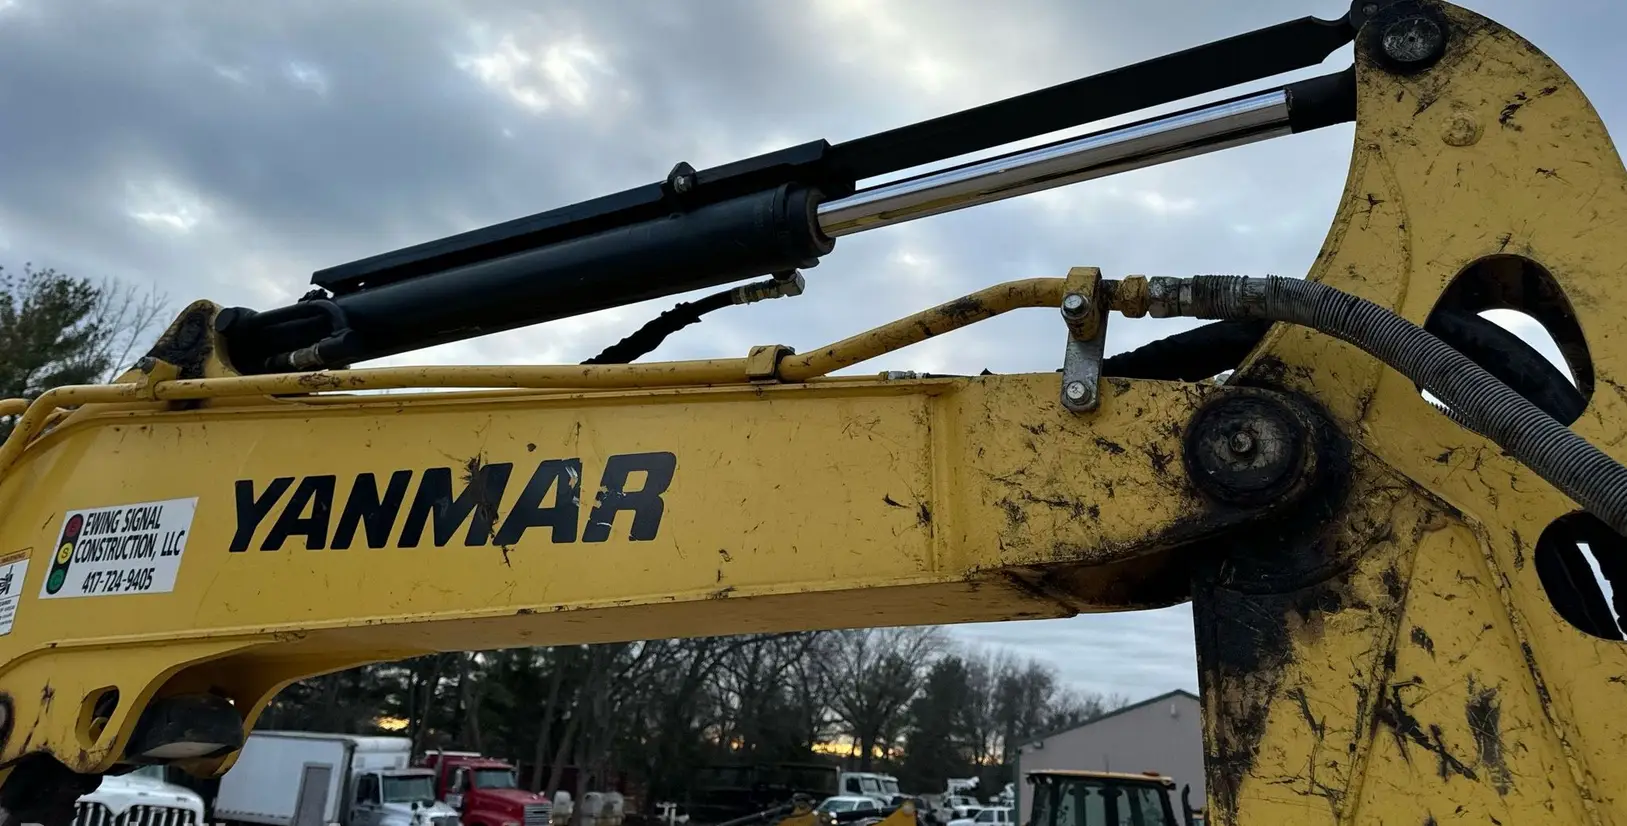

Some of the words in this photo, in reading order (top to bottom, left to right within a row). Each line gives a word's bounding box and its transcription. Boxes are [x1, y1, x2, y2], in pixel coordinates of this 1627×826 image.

[229, 452, 677, 552] YANMAR
[83, 509, 122, 536] EWING
[121, 505, 163, 532] SIGNAL
[61, 547, 70, 559] S
[75, 533, 158, 563] CONSTRUCTION,
[160, 530, 185, 556] LLC
[82, 567, 155, 593] 417-724-9405
